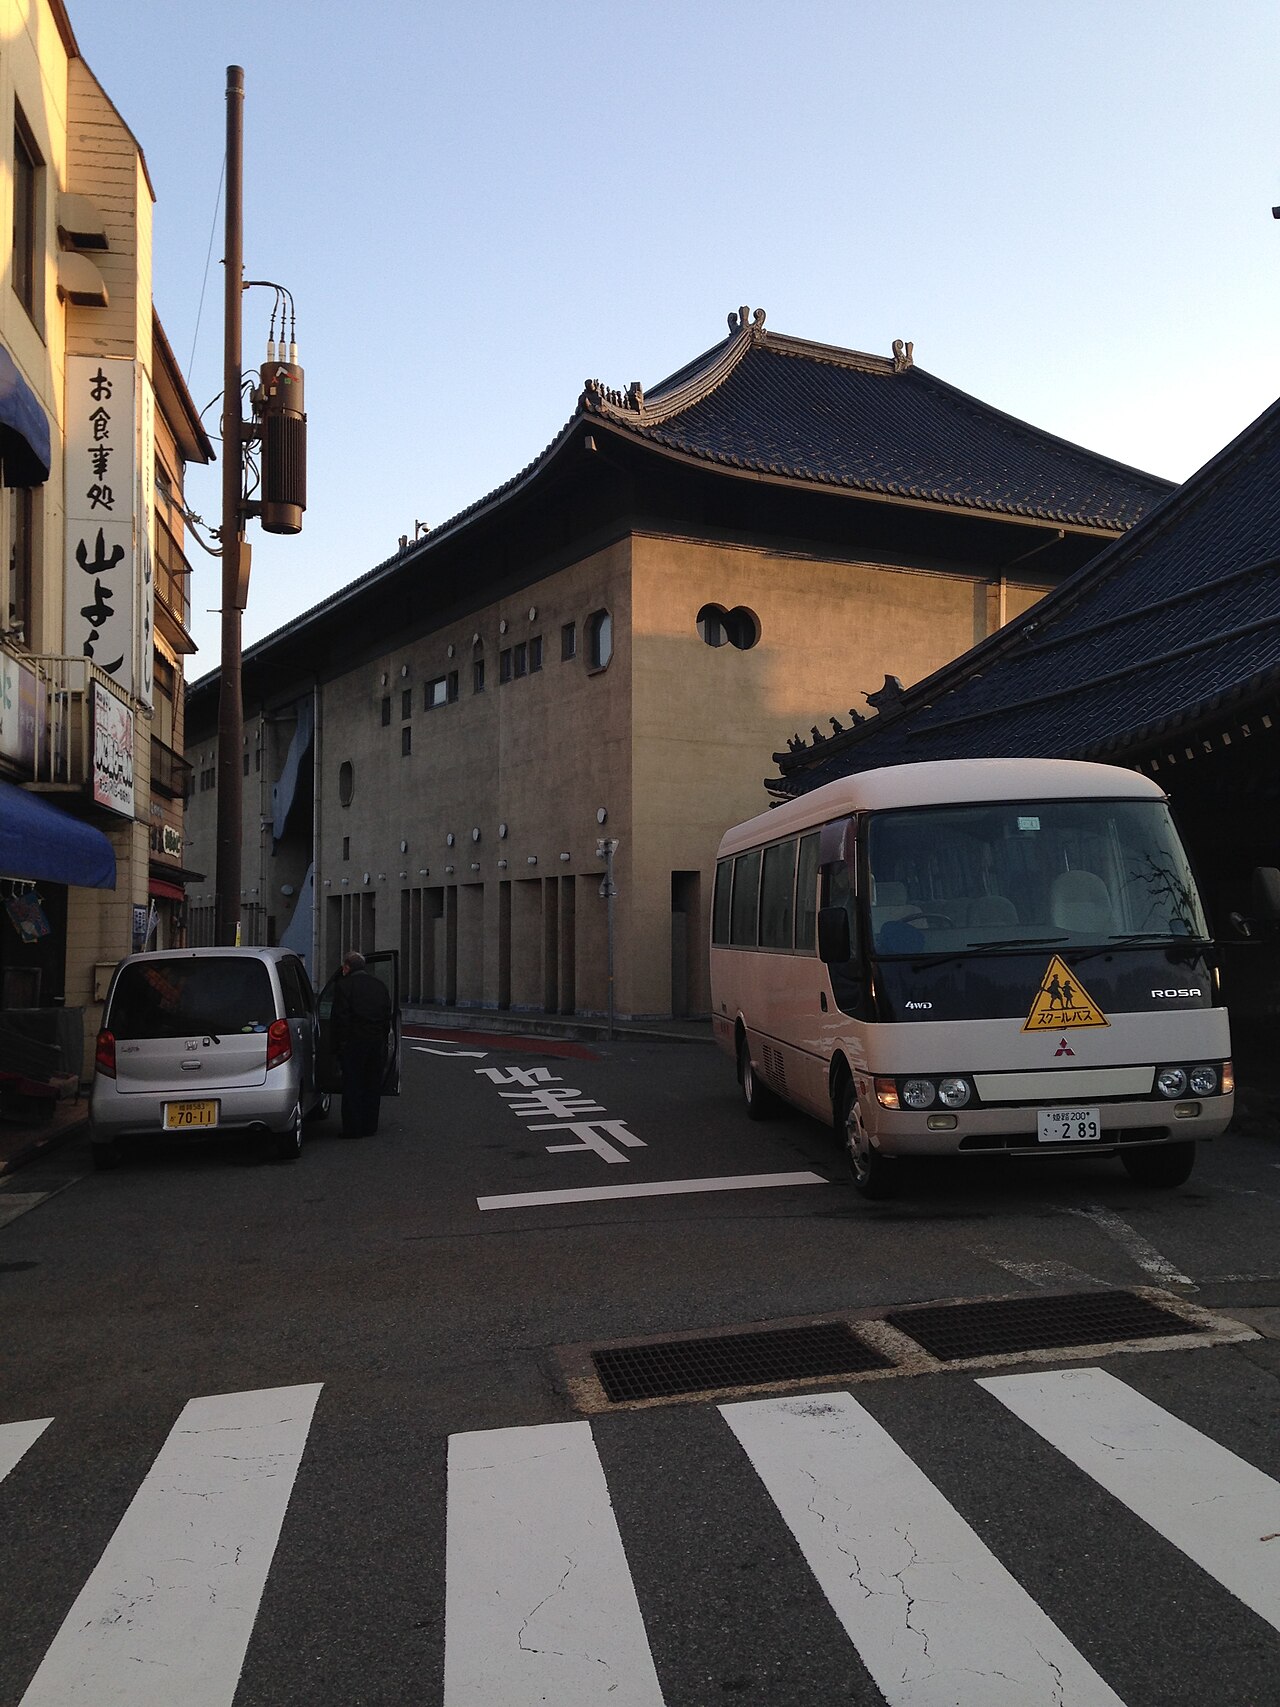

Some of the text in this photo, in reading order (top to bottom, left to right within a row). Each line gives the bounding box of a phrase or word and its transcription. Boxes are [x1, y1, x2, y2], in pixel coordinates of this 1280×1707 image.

[87, 367, 115, 511] お食事処
[76, 527, 125, 674] 山よし
[1151, 988, 1202, 999] ROSA
[905, 1000, 933, 1010] 4WD
[1037, 1010, 1094, 1026] スクールバス
[178, 1111, 211, 1125] 70-11
[474, 1066, 648, 1164] 止まれ
